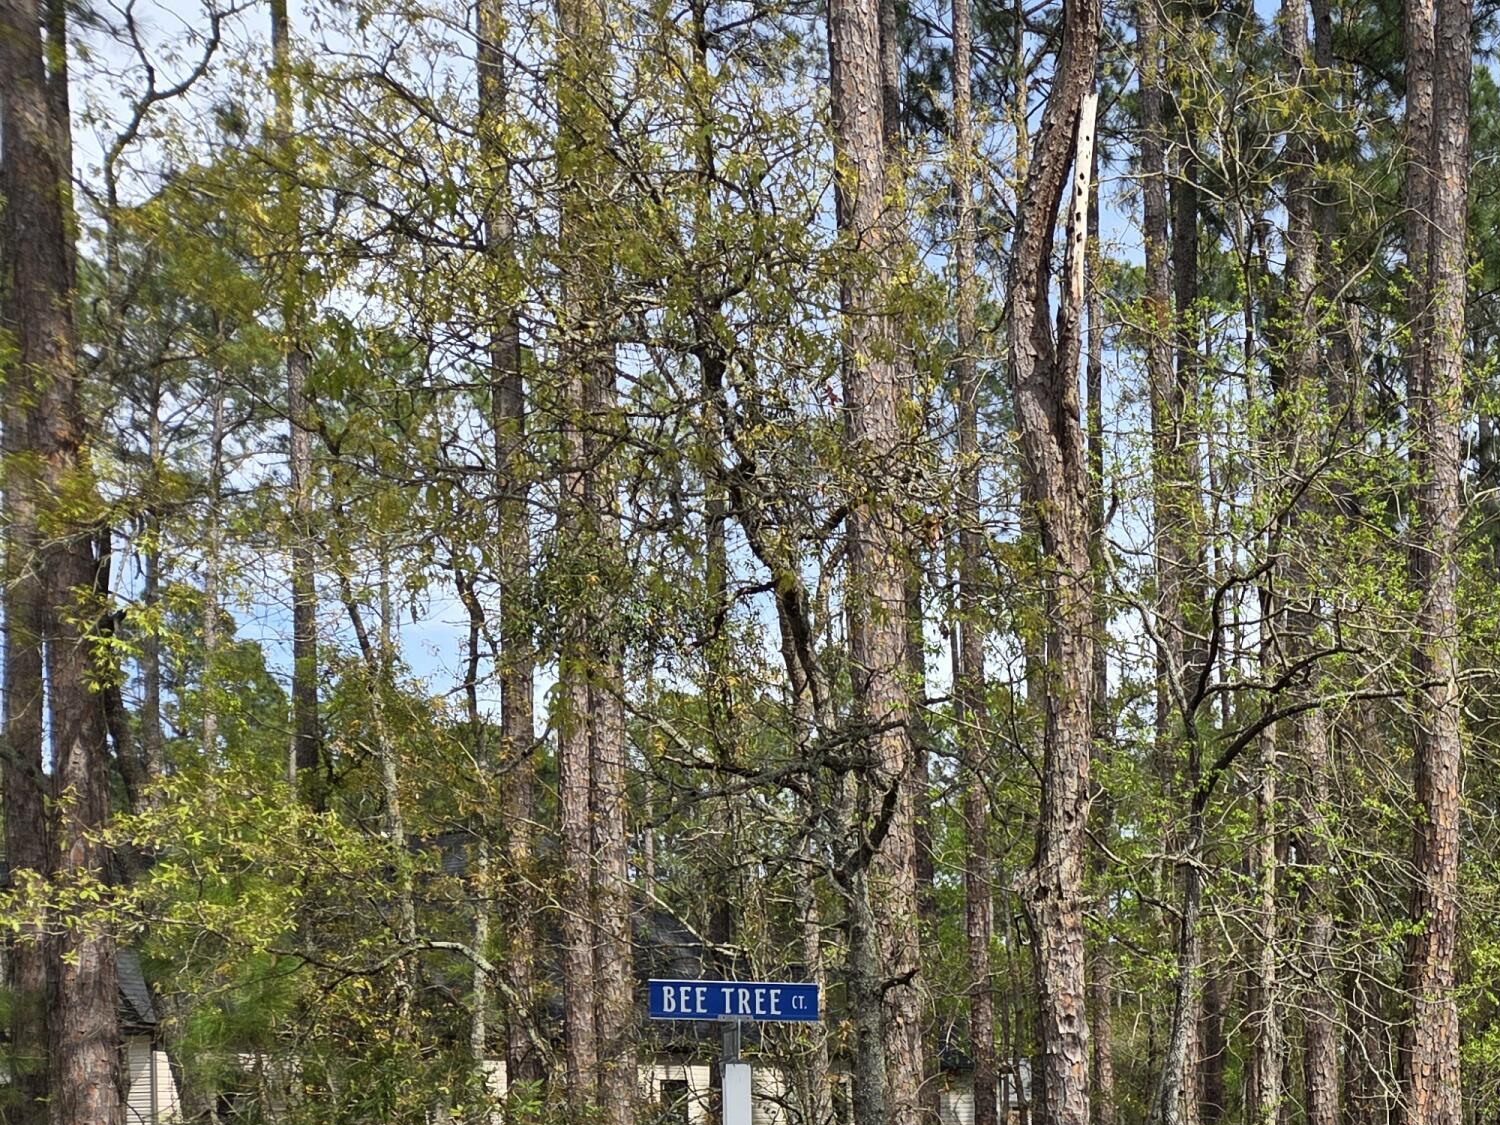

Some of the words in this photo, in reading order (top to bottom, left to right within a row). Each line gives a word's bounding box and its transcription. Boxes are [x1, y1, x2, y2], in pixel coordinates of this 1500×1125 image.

[662, 986, 708, 1013] BEE
[721, 988, 782, 1015] TREE
[791, 995, 808, 1010] CT.
